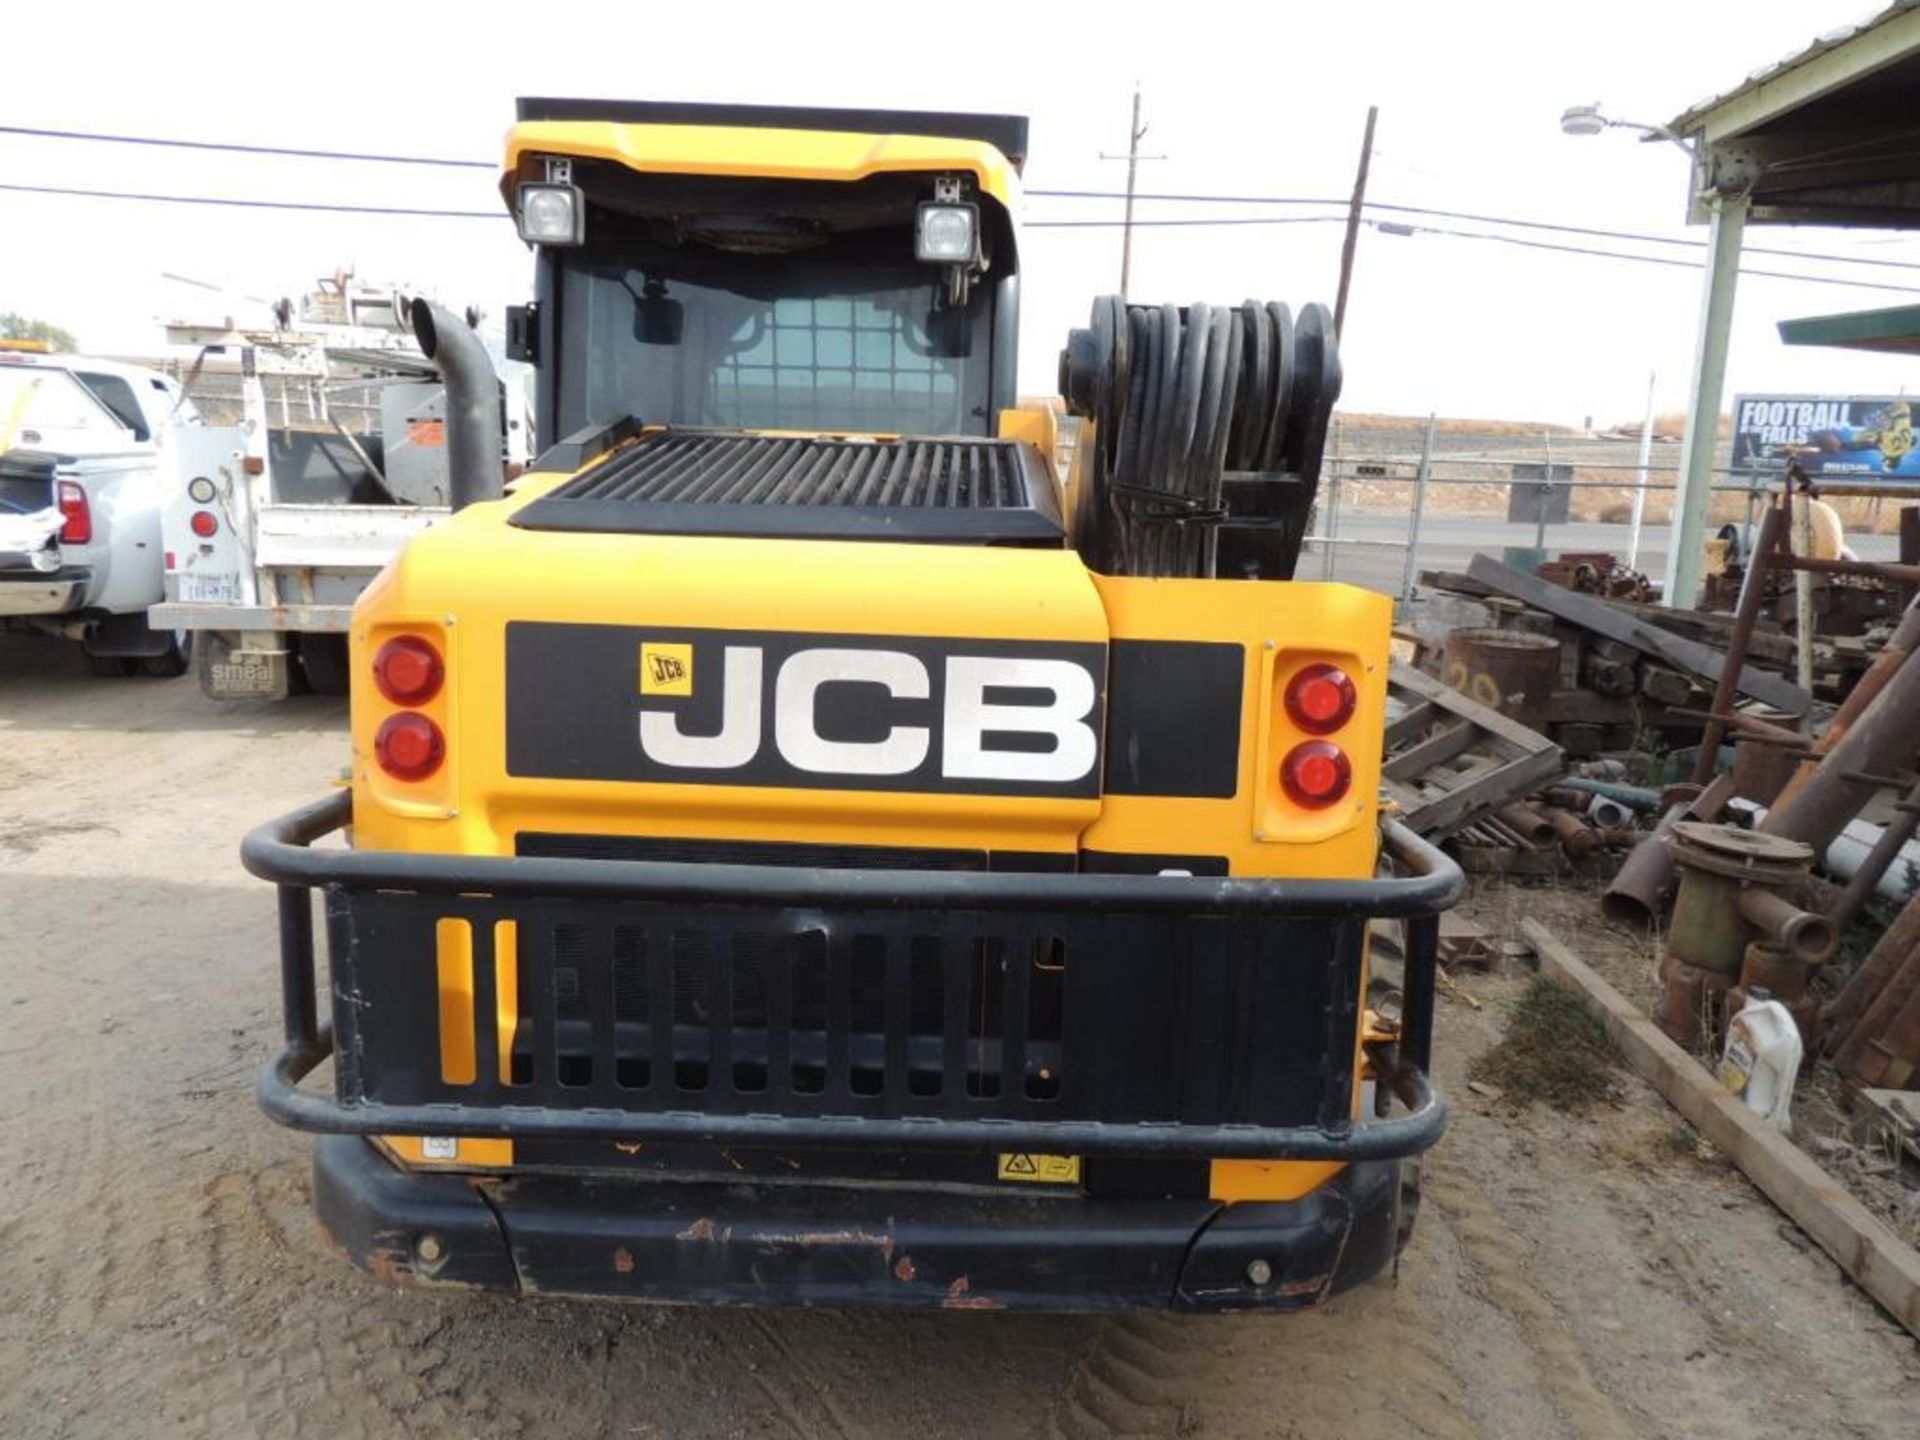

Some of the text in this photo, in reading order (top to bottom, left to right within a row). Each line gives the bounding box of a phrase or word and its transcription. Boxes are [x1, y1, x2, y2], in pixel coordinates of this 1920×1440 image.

[1741, 401, 1851, 431] FOOTBALL
[1760, 426, 1809, 445] FALLS
[211, 657, 273, 681] smeal
[655, 656, 683, 681] JCB
[639, 645, 1097, 782] JCB
